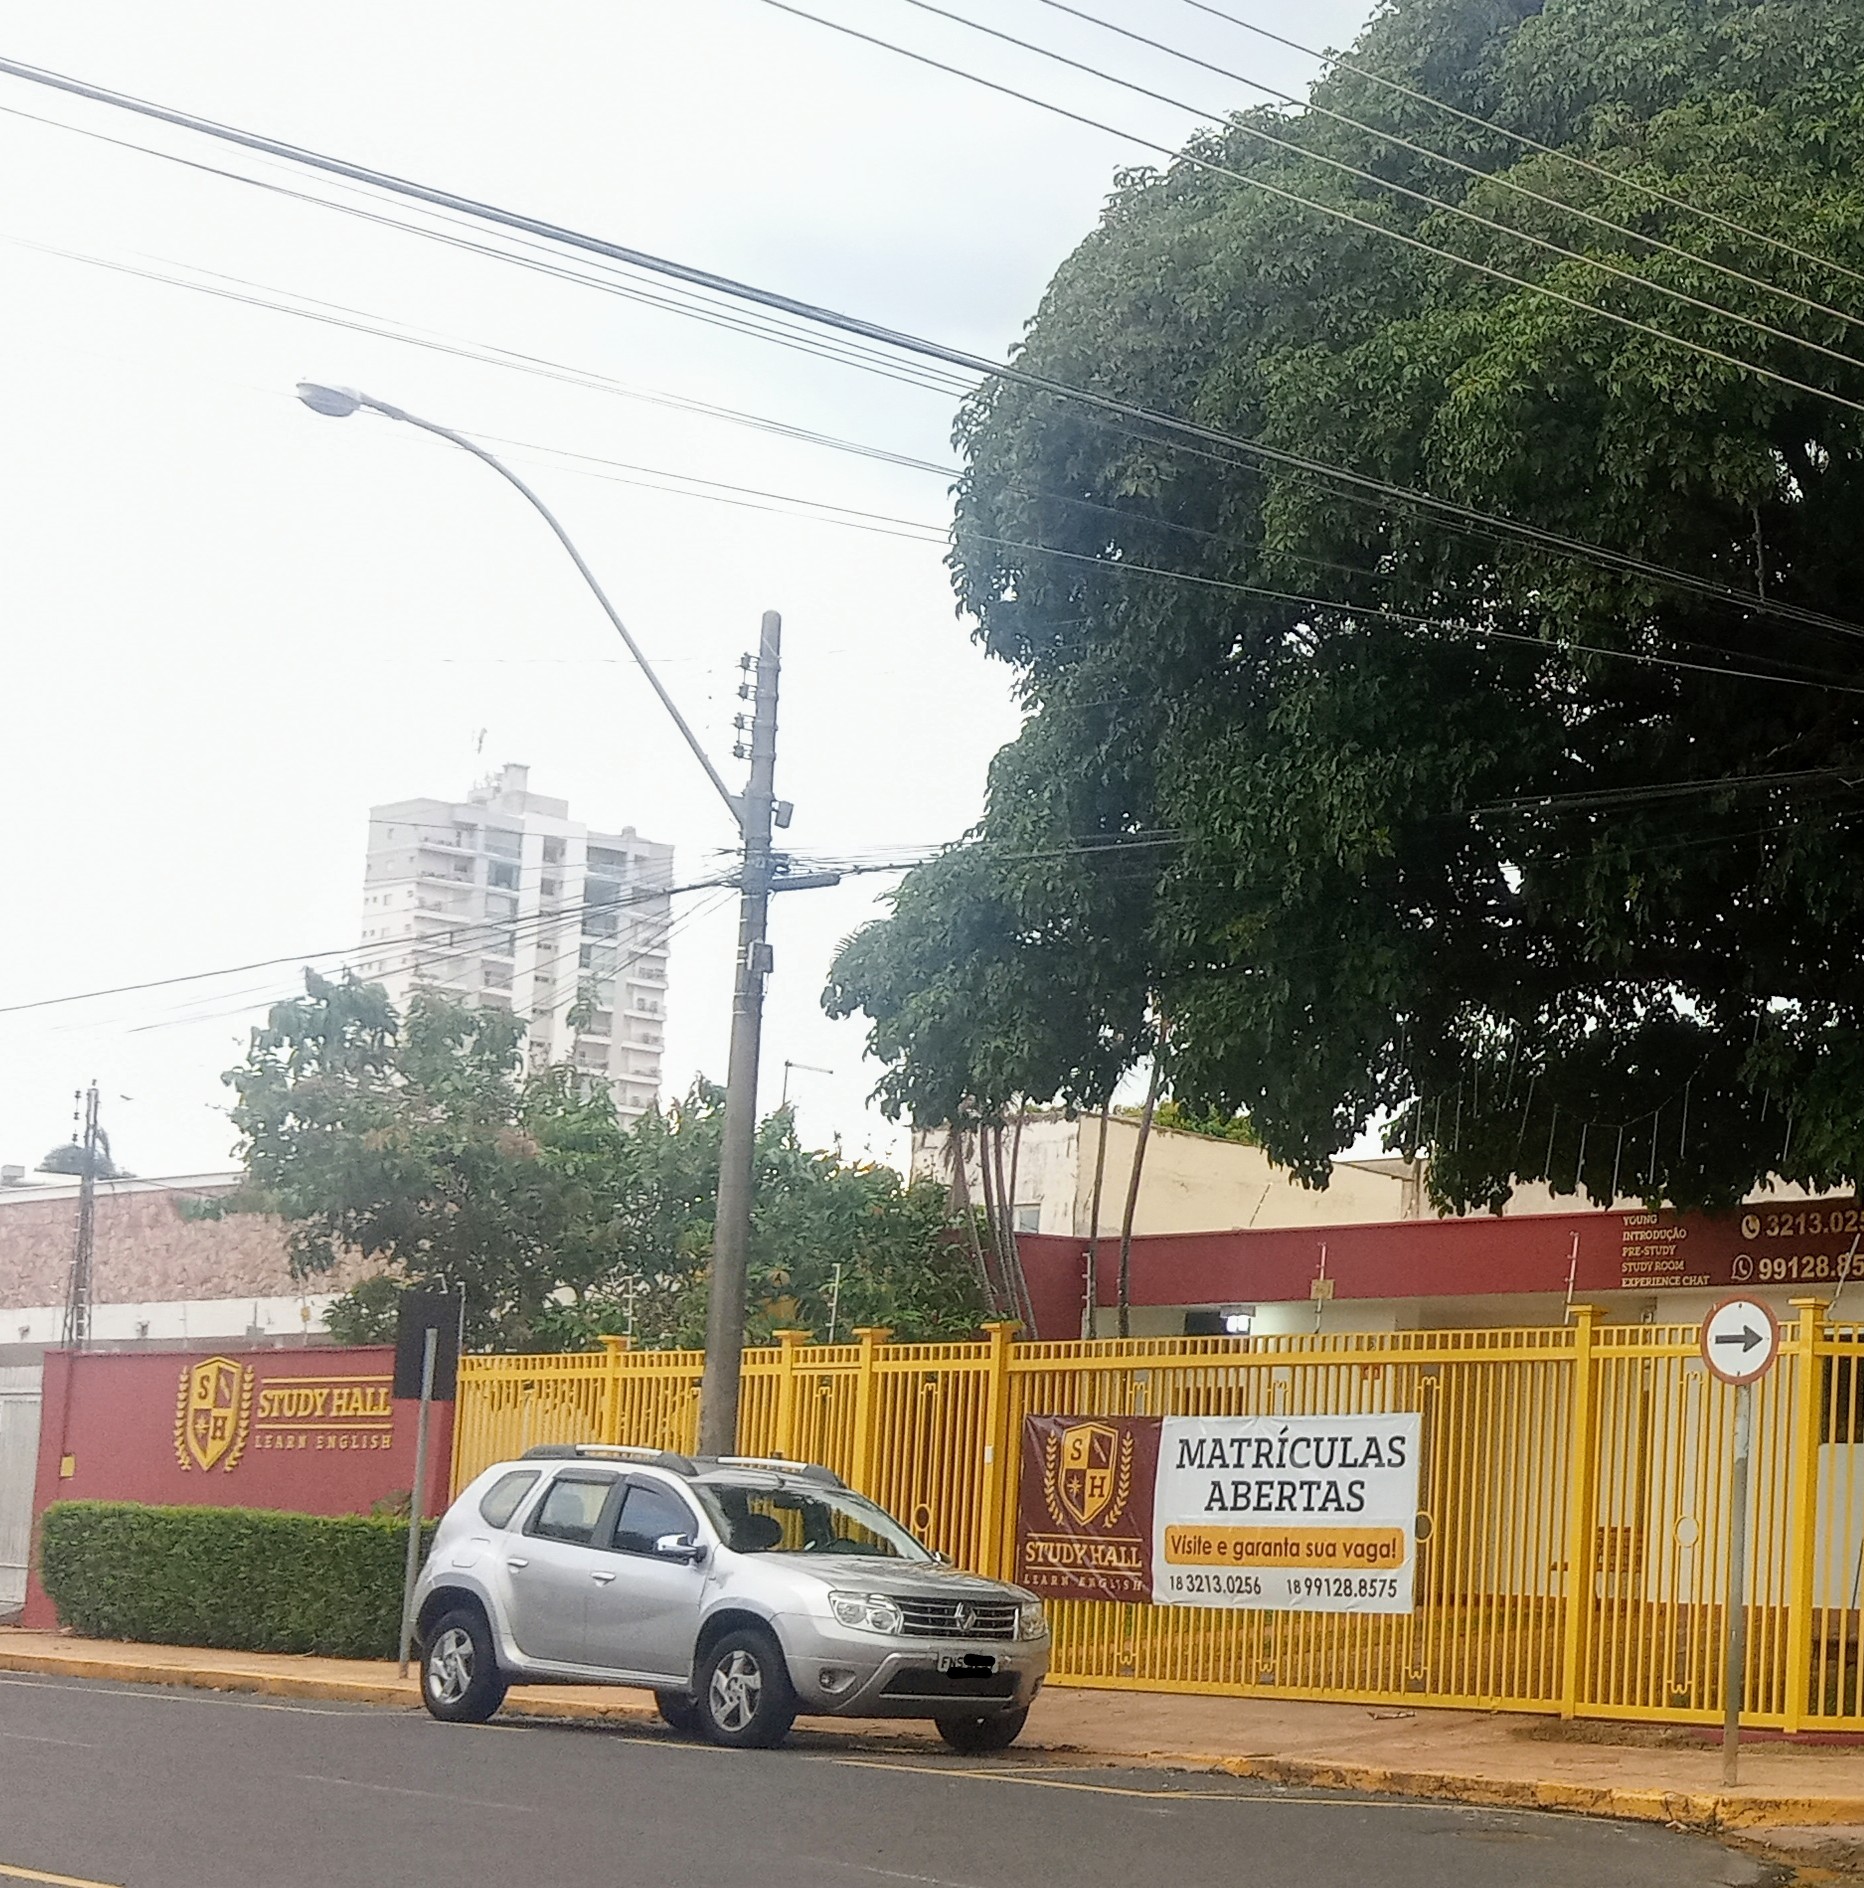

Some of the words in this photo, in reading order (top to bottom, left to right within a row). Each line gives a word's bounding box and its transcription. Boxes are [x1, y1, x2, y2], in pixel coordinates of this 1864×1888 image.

[1622, 1214, 1658, 1226] YOUNG
[1622, 1227, 1687, 1241] INTRODUÇÃO
[1622, 1245, 1677, 1257] PRE-STUDY
[1622, 1261, 1653, 1273] STUDY
[1655, 1260, 1685, 1271] ROOM
[1621, 1276, 1681, 1288] EXPERIENCE
[1682, 1275, 1710, 1286] CHAT
[199, 1374, 210, 1399] S
[257, 1388, 330, 1418] STUDY
[330, 1387, 393, 1417] HALL
[211, 1416, 228, 1440] H
[254, 1435, 308, 1449] LEARN
[316, 1435, 392, 1449] ENGLISH
[1071, 1438, 1083, 1461] S
[1176, 1425, 1407, 1469] MATRÍCULAS
[1088, 1475, 1106, 1498] H
[1204, 1479, 1365, 1512] ABERTAS
[1025, 1541, 1088, 1564] STUDY
[1090, 1544, 1143, 1568] HALL
[1170, 1535, 1212, 1555] Visite
[1217, 1542, 1227, 1556] e
[1233, 1537, 1300, 1561] garanta
[1305, 1541, 1337, 1558] sua
[1342, 1538, 1397, 1563] vaga!
[1023, 1573, 1069, 1586] LEARN
[1078, 1576, 1143, 1591] ENGLISH
[1169, 1575, 1183, 1591] 18
[1186, 1574, 1262, 1595] 3213.0256
[1287, 1578, 1301, 1595] 18
[1304, 1577, 1398, 1598] 99128.8575
